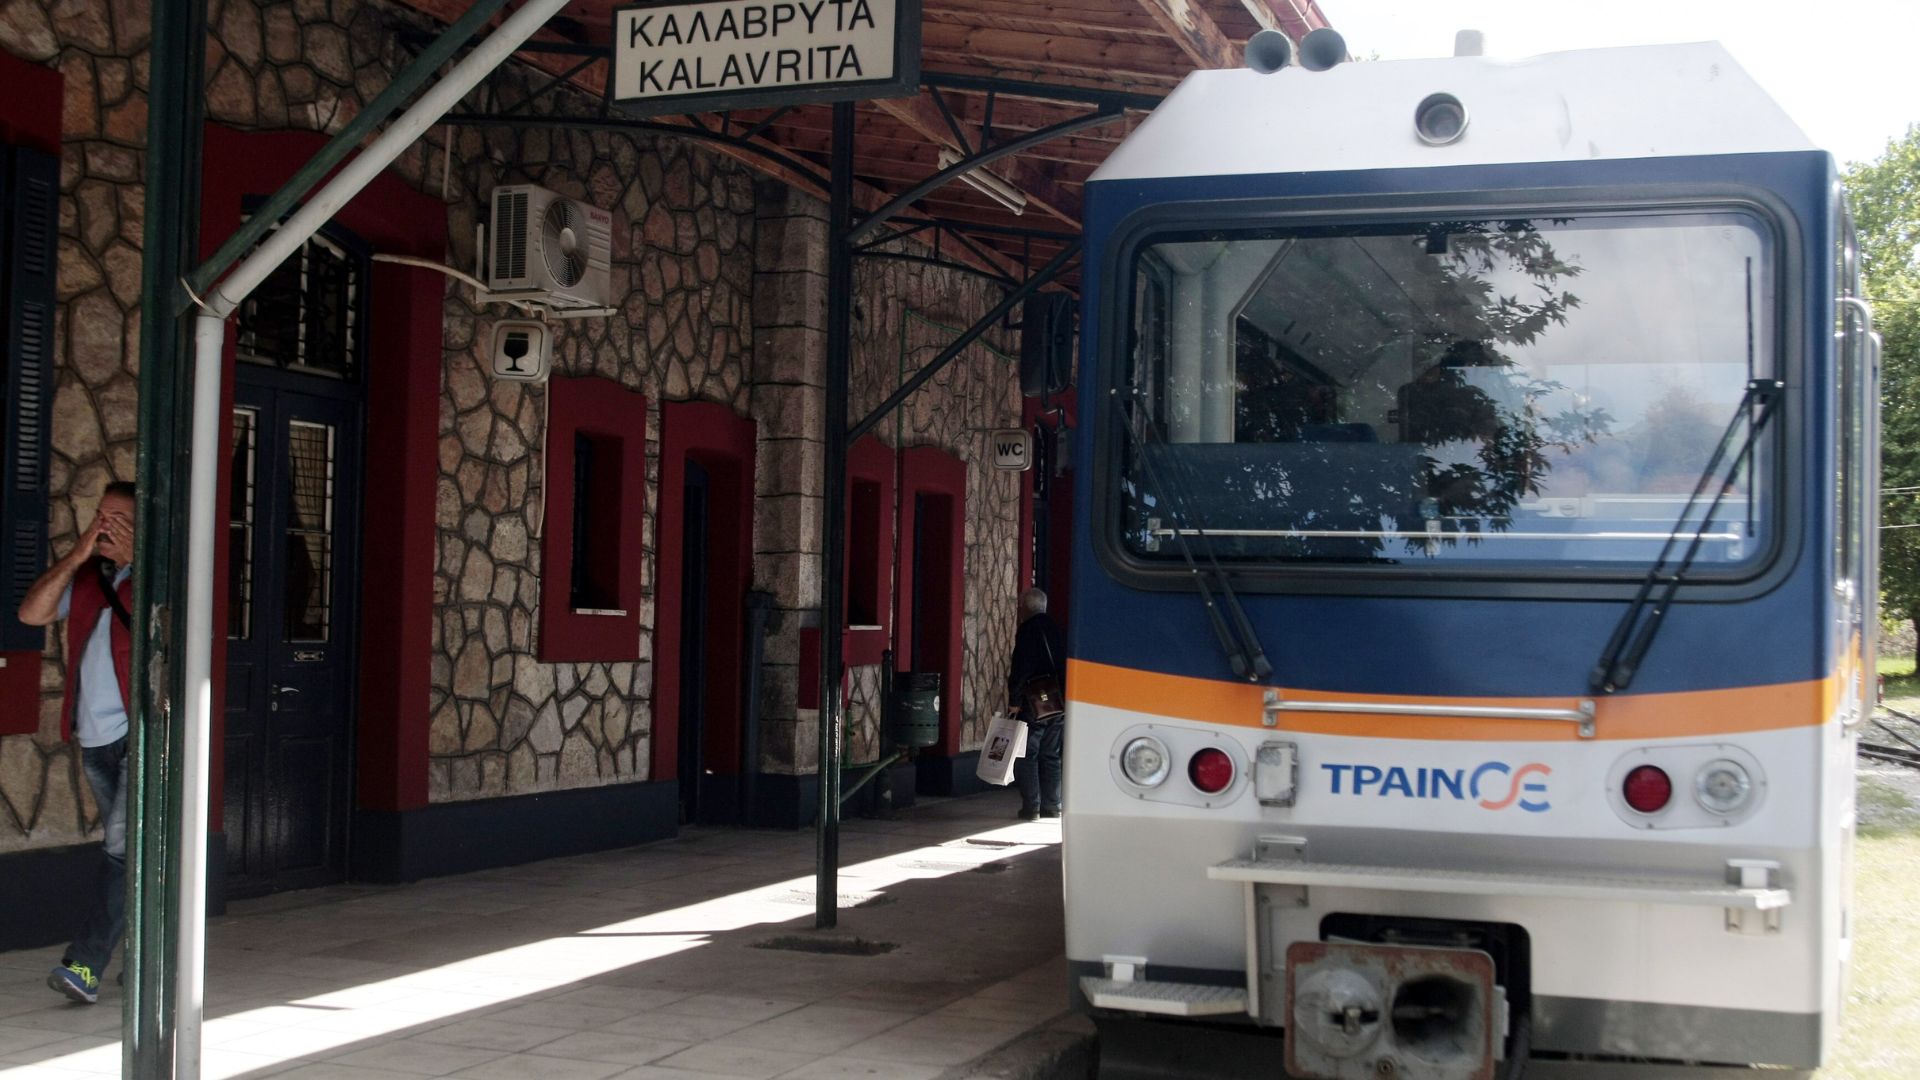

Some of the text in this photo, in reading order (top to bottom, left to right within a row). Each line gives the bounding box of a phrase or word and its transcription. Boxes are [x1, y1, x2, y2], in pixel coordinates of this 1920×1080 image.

[630, 0, 875, 48] ΚΑΛΑΒΡΥΤΑ
[639, 44, 863, 93] KALAVRITA
[997, 442, 1023, 457] WC
